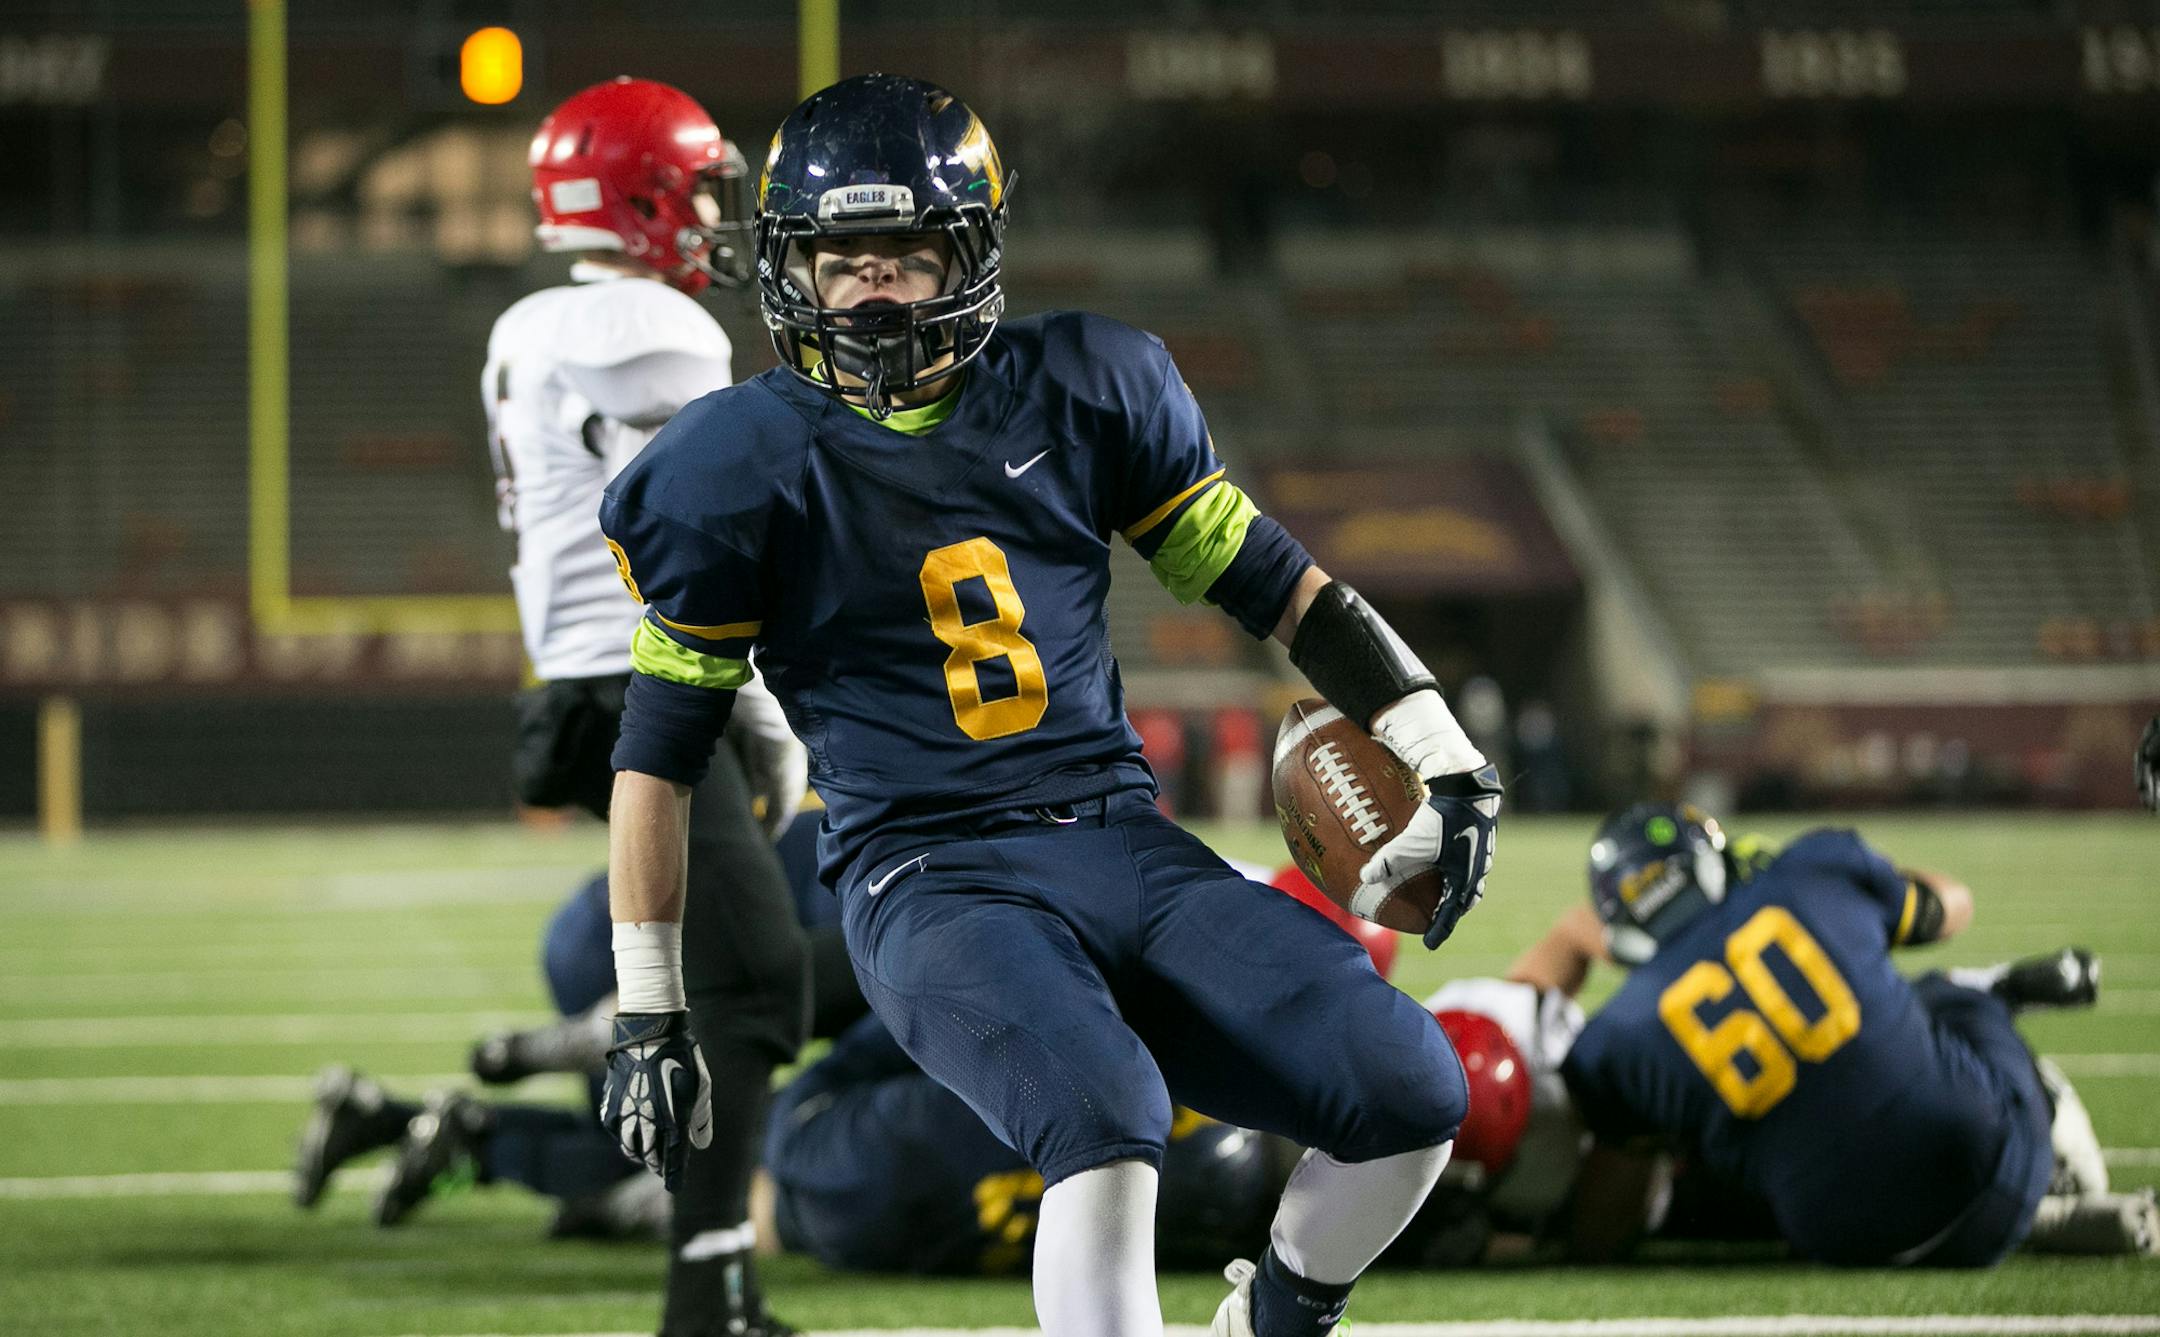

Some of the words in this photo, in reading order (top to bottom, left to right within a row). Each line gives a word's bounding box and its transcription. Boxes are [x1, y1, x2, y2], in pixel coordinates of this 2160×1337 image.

[846, 191, 886, 205] EAGLES
[919, 536, 1049, 741] 8
[1287, 793, 1327, 859] SPALDING
[1658, 905, 1862, 1120] 60
